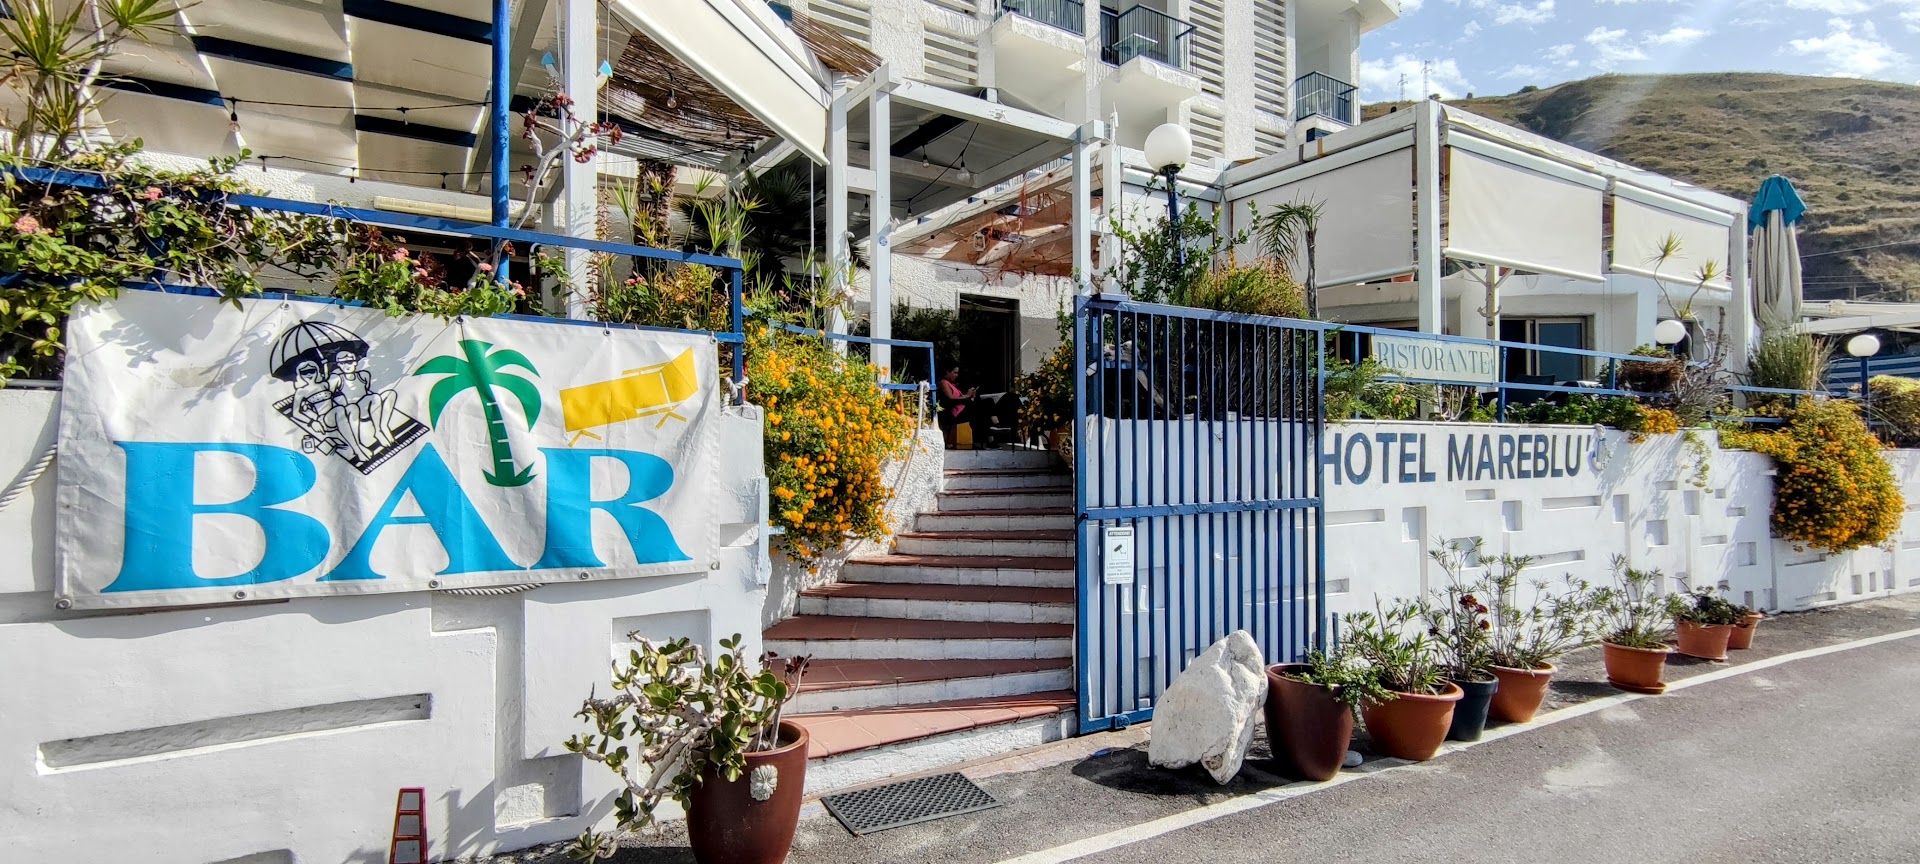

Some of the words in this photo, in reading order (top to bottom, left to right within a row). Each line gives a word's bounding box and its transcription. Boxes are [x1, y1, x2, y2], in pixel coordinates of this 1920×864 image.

[1377, 341, 1491, 375] RISTORANTE
[1321, 432, 1436, 485] HOTEL
[100, 441, 693, 593] BAR
